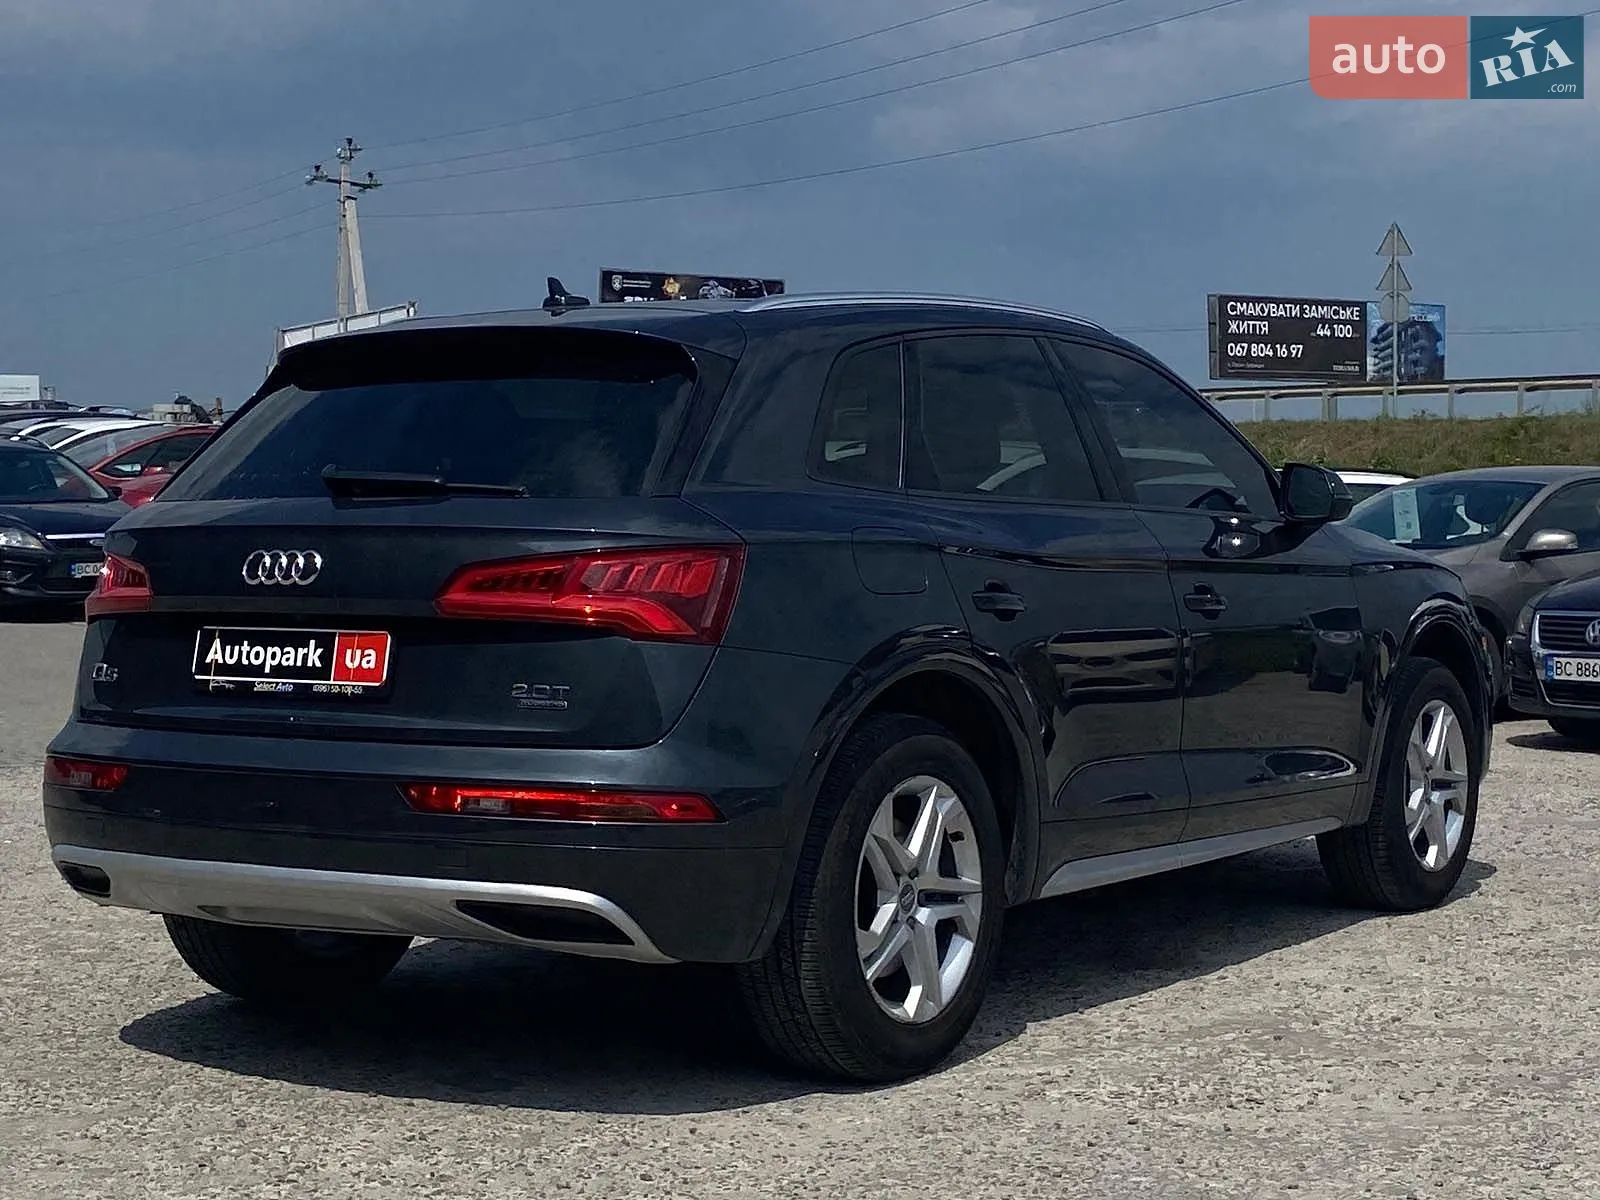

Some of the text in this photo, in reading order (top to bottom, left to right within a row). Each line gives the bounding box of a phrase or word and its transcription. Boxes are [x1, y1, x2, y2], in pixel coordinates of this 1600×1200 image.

[1227, 301, 1360, 320] СМАКУВАТИ ЗАМІСЬКЕ
[1228, 320, 1269, 336] ЖИТТЯ
[1316, 324, 1331, 337] 44
[1333, 324, 1353, 338] 100
[1227, 342, 1303, 359] 067 804 16 97
[205, 638, 377, 674] Autopark ua
[1555, 660, 1600, 679] BC 886
